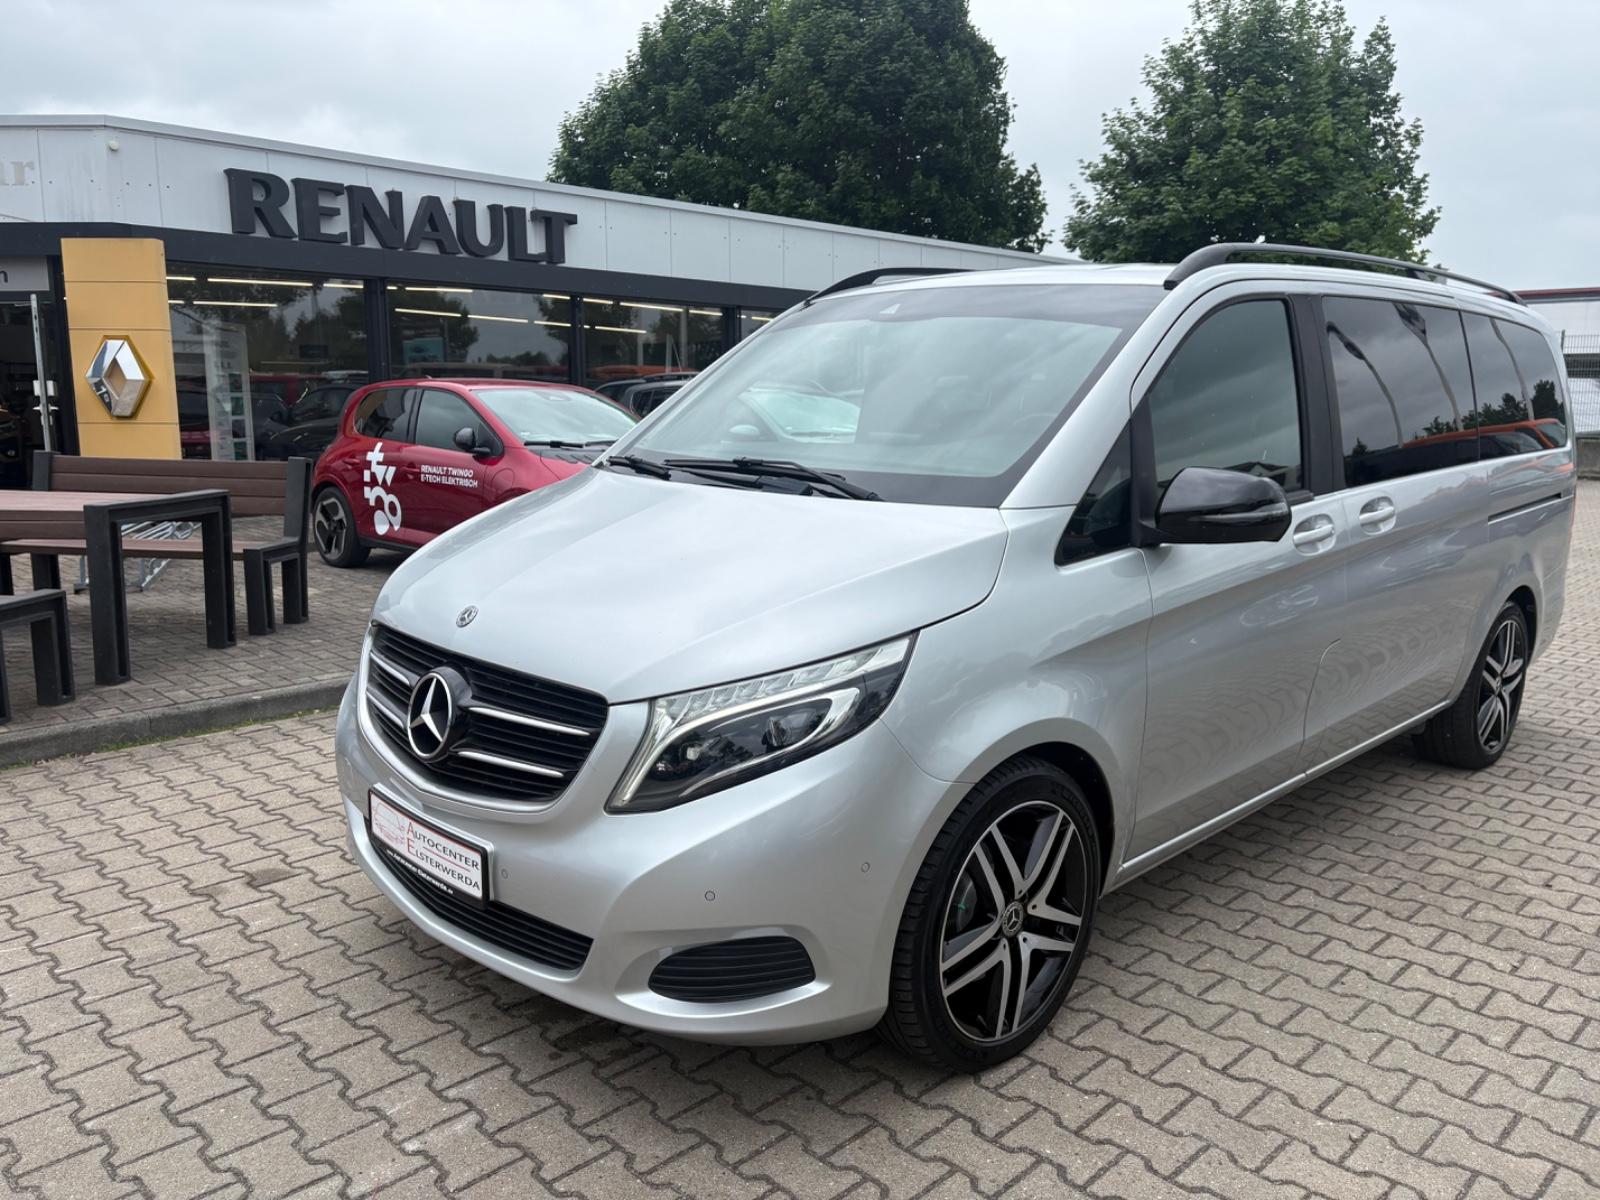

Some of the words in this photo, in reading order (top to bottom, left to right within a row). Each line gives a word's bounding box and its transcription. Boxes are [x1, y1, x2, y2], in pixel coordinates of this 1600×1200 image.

[224, 168, 578, 264] RENAULT
[420, 464, 447, 475] RENAULT
[448, 467, 474, 478] TWINGO
[420, 473, 441, 484] E-TECH
[441, 476, 478, 488] ELEKTRISCH
